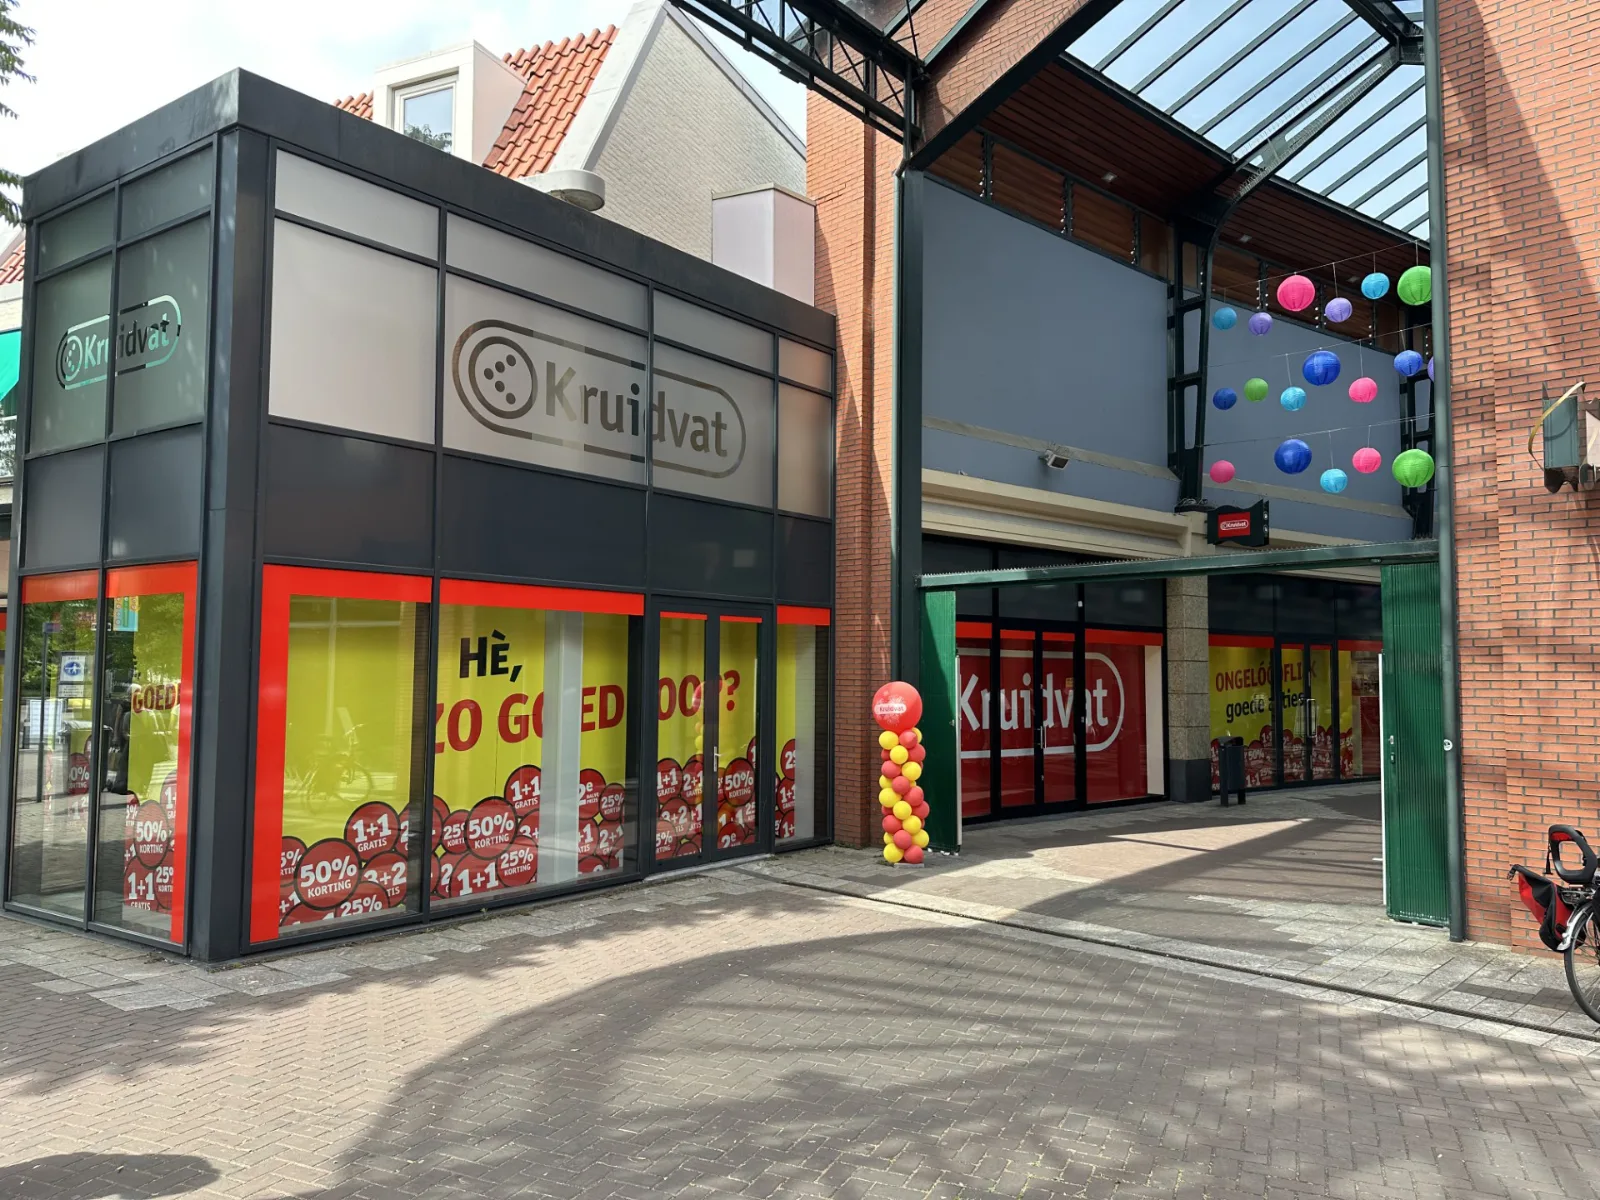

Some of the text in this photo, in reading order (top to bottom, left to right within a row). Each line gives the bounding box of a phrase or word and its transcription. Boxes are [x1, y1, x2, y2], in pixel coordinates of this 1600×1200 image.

[545, 361, 728, 457] Kruidvat
[459, 629, 523, 683] HÈ,
[132, 683, 181, 714] GOED
[1226, 688, 1305, 723] goede aties
[68, 766, 90, 781] 0%
[725, 771, 753, 791] 50%
[510, 776, 540, 801] 1+1
[514, 798, 538, 809] GRATIS
[135, 820, 167, 843] 50%
[352, 813, 392, 843] 1+1
[468, 812, 515, 840] 50%
[139, 843, 163, 854] KORTING
[357, 838, 388, 852] GRATIS
[474, 833, 510, 849] KORTING
[500, 847, 534, 869] 25%
[504, 863, 531, 876] KORTING
[300, 855, 357, 888] 50%
[457, 862, 499, 896] 1+1
[128, 872, 155, 901] 1+1
[307, 879, 352, 898] KORTING
[340, 894, 382, 917] 25%
